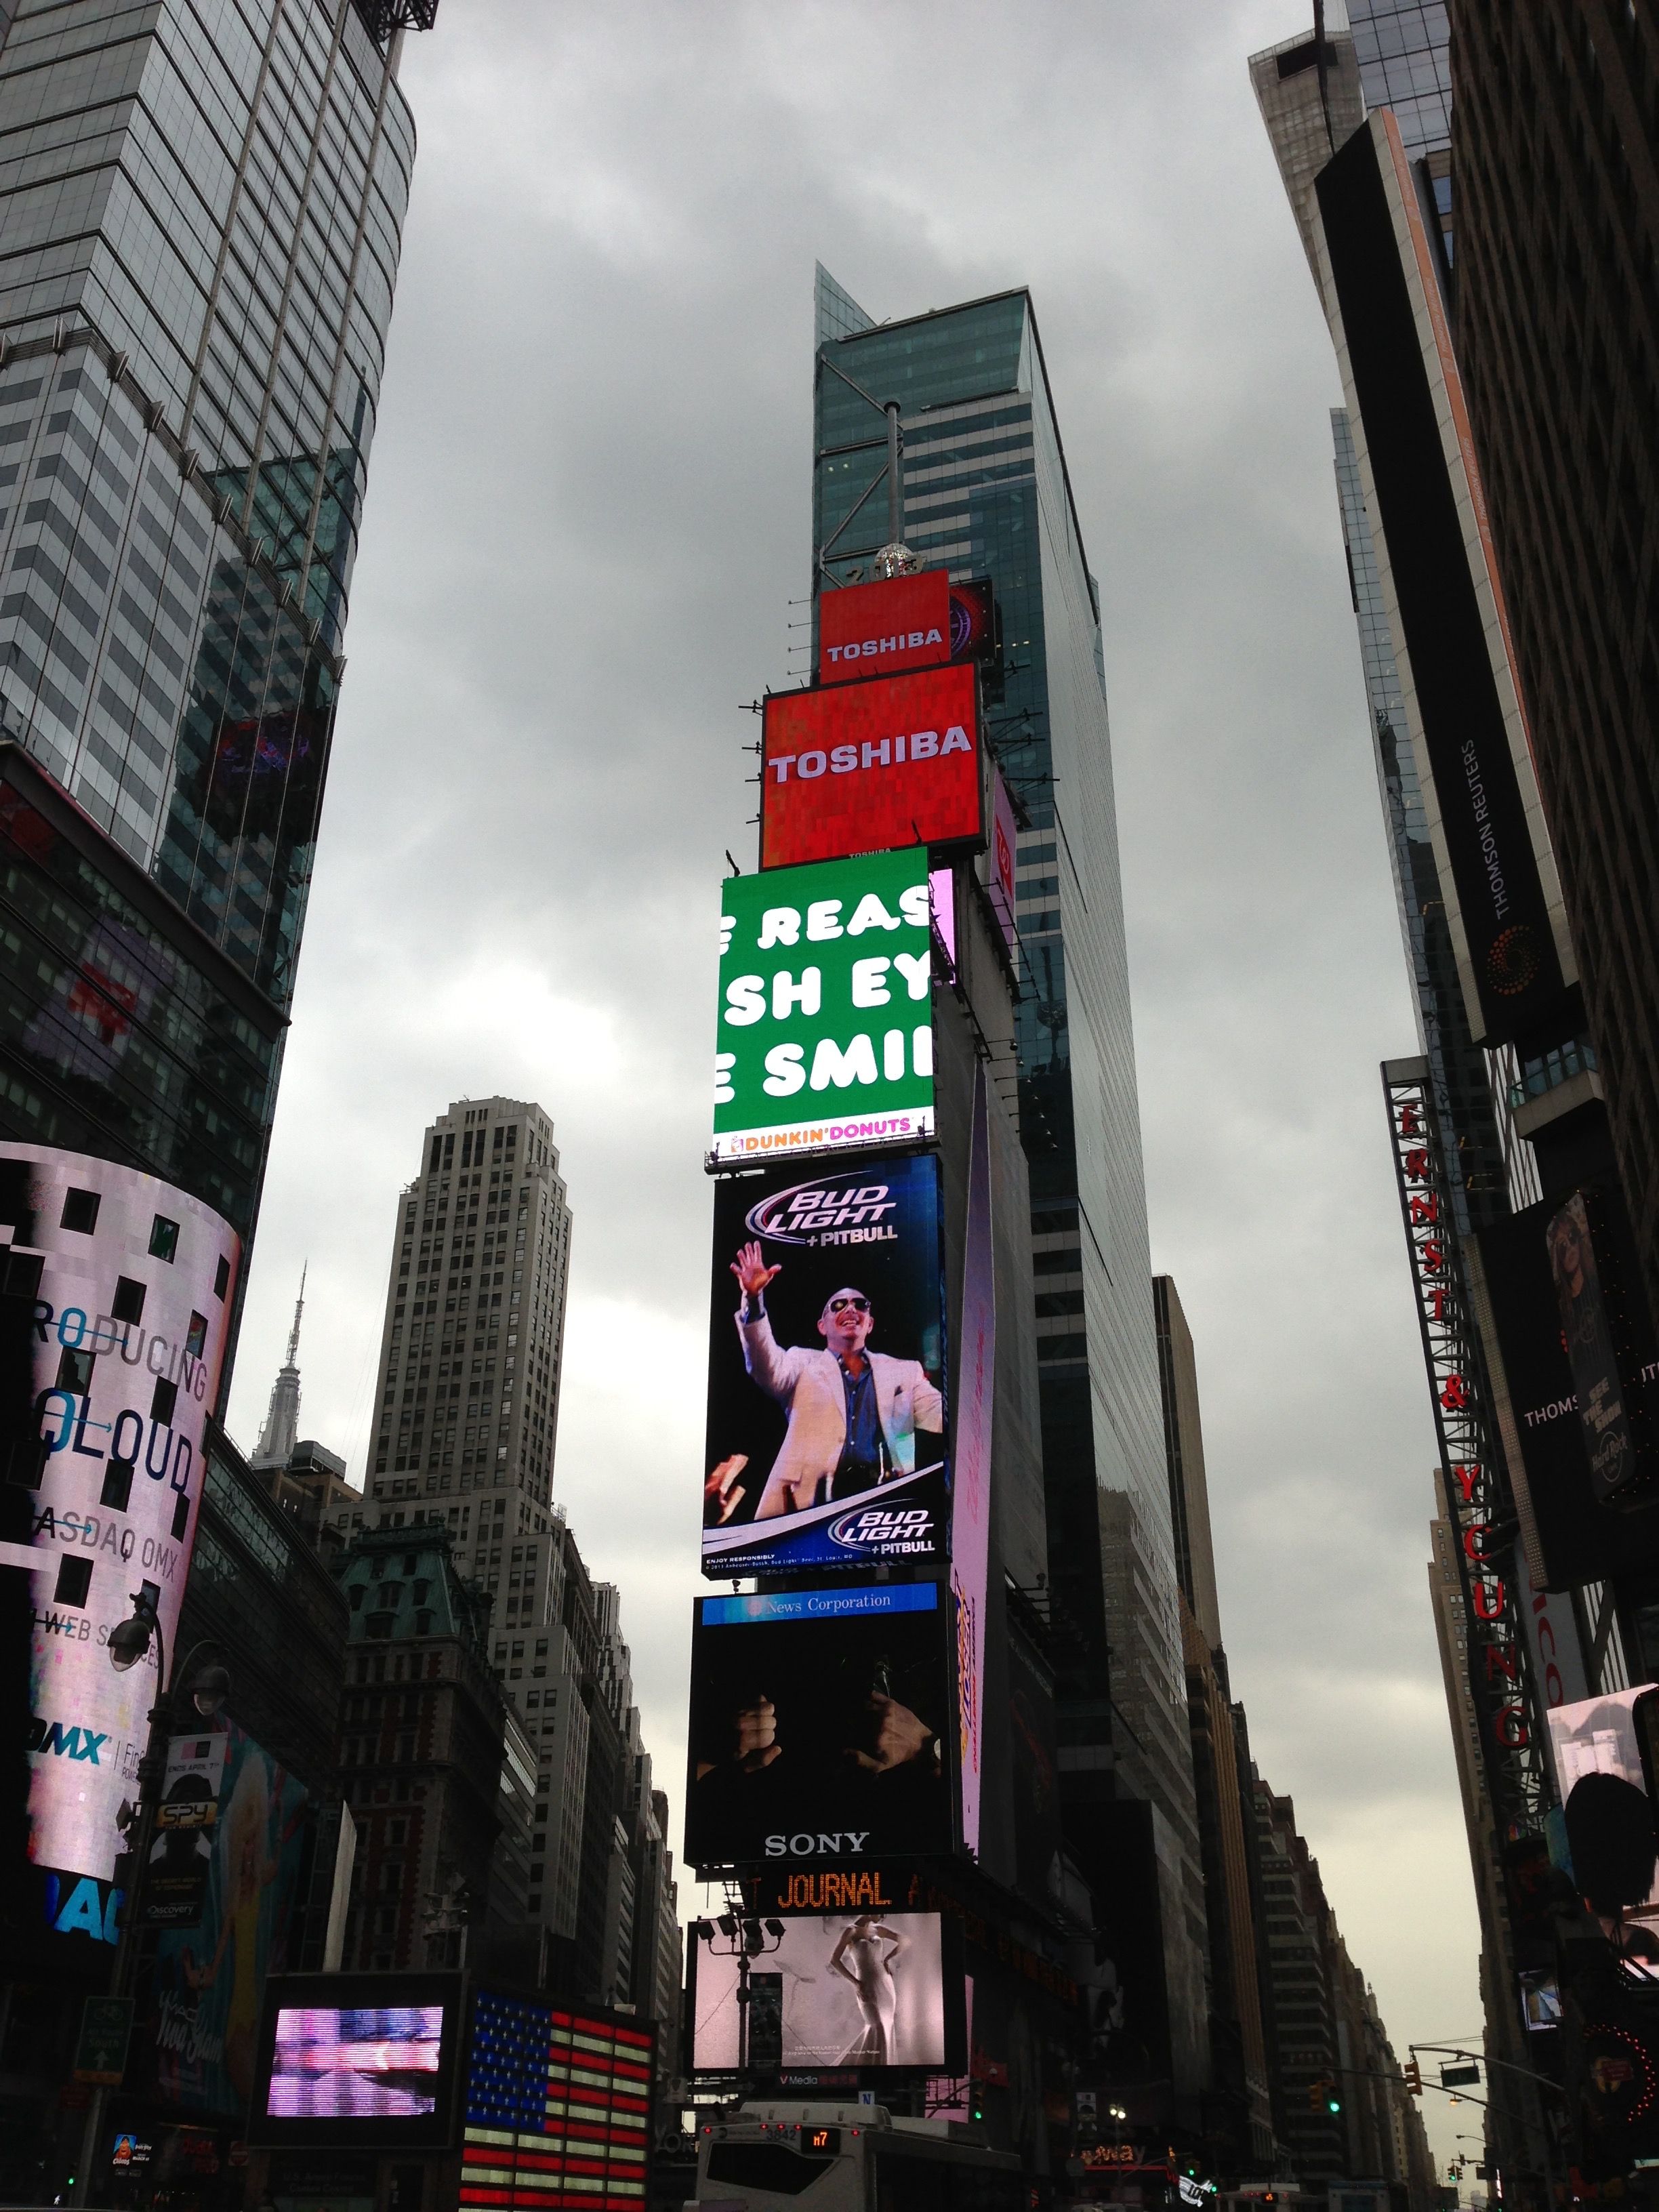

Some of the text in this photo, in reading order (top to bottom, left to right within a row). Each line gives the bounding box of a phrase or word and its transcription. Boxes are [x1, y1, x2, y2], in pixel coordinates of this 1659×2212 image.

[827, 629, 942, 662] TOSHIBA
[769, 725, 972, 783] TOSHIBA
[1460, 739, 1510, 920] THOMSON REUTERS
[848, 848, 891, 859] TOSHIBA
[724, 966, 821, 1027] SH
[830, 1117, 911, 1141] DONUTS
[787, 1185, 889, 1213] BUD
[764, 1202, 897, 1233] LIGHT
[1401, 1104, 1450, 1322] ERNST
[821, 1225, 899, 1247] PITBULL
[857, 1509, 928, 1528] BUD
[35, 1507, 178, 1583] ASDAQ OMX
[841, 1523, 935, 1543] LIGHT
[729, 1554, 775, 1562] RESPONSIBLY
[881, 1540, 936, 1555] PITBULL
[766, 1594, 890, 1614] News Corporation
[45, 1611, 91, 1641] WEB
[163, 1804, 208, 1824] SPY
[764, 1832, 870, 1856] SONY
[778, 1872, 893, 1908] JOURNAL
[789, 2075, 818, 2085] Media
[766, 2129, 796, 2142] 3842
